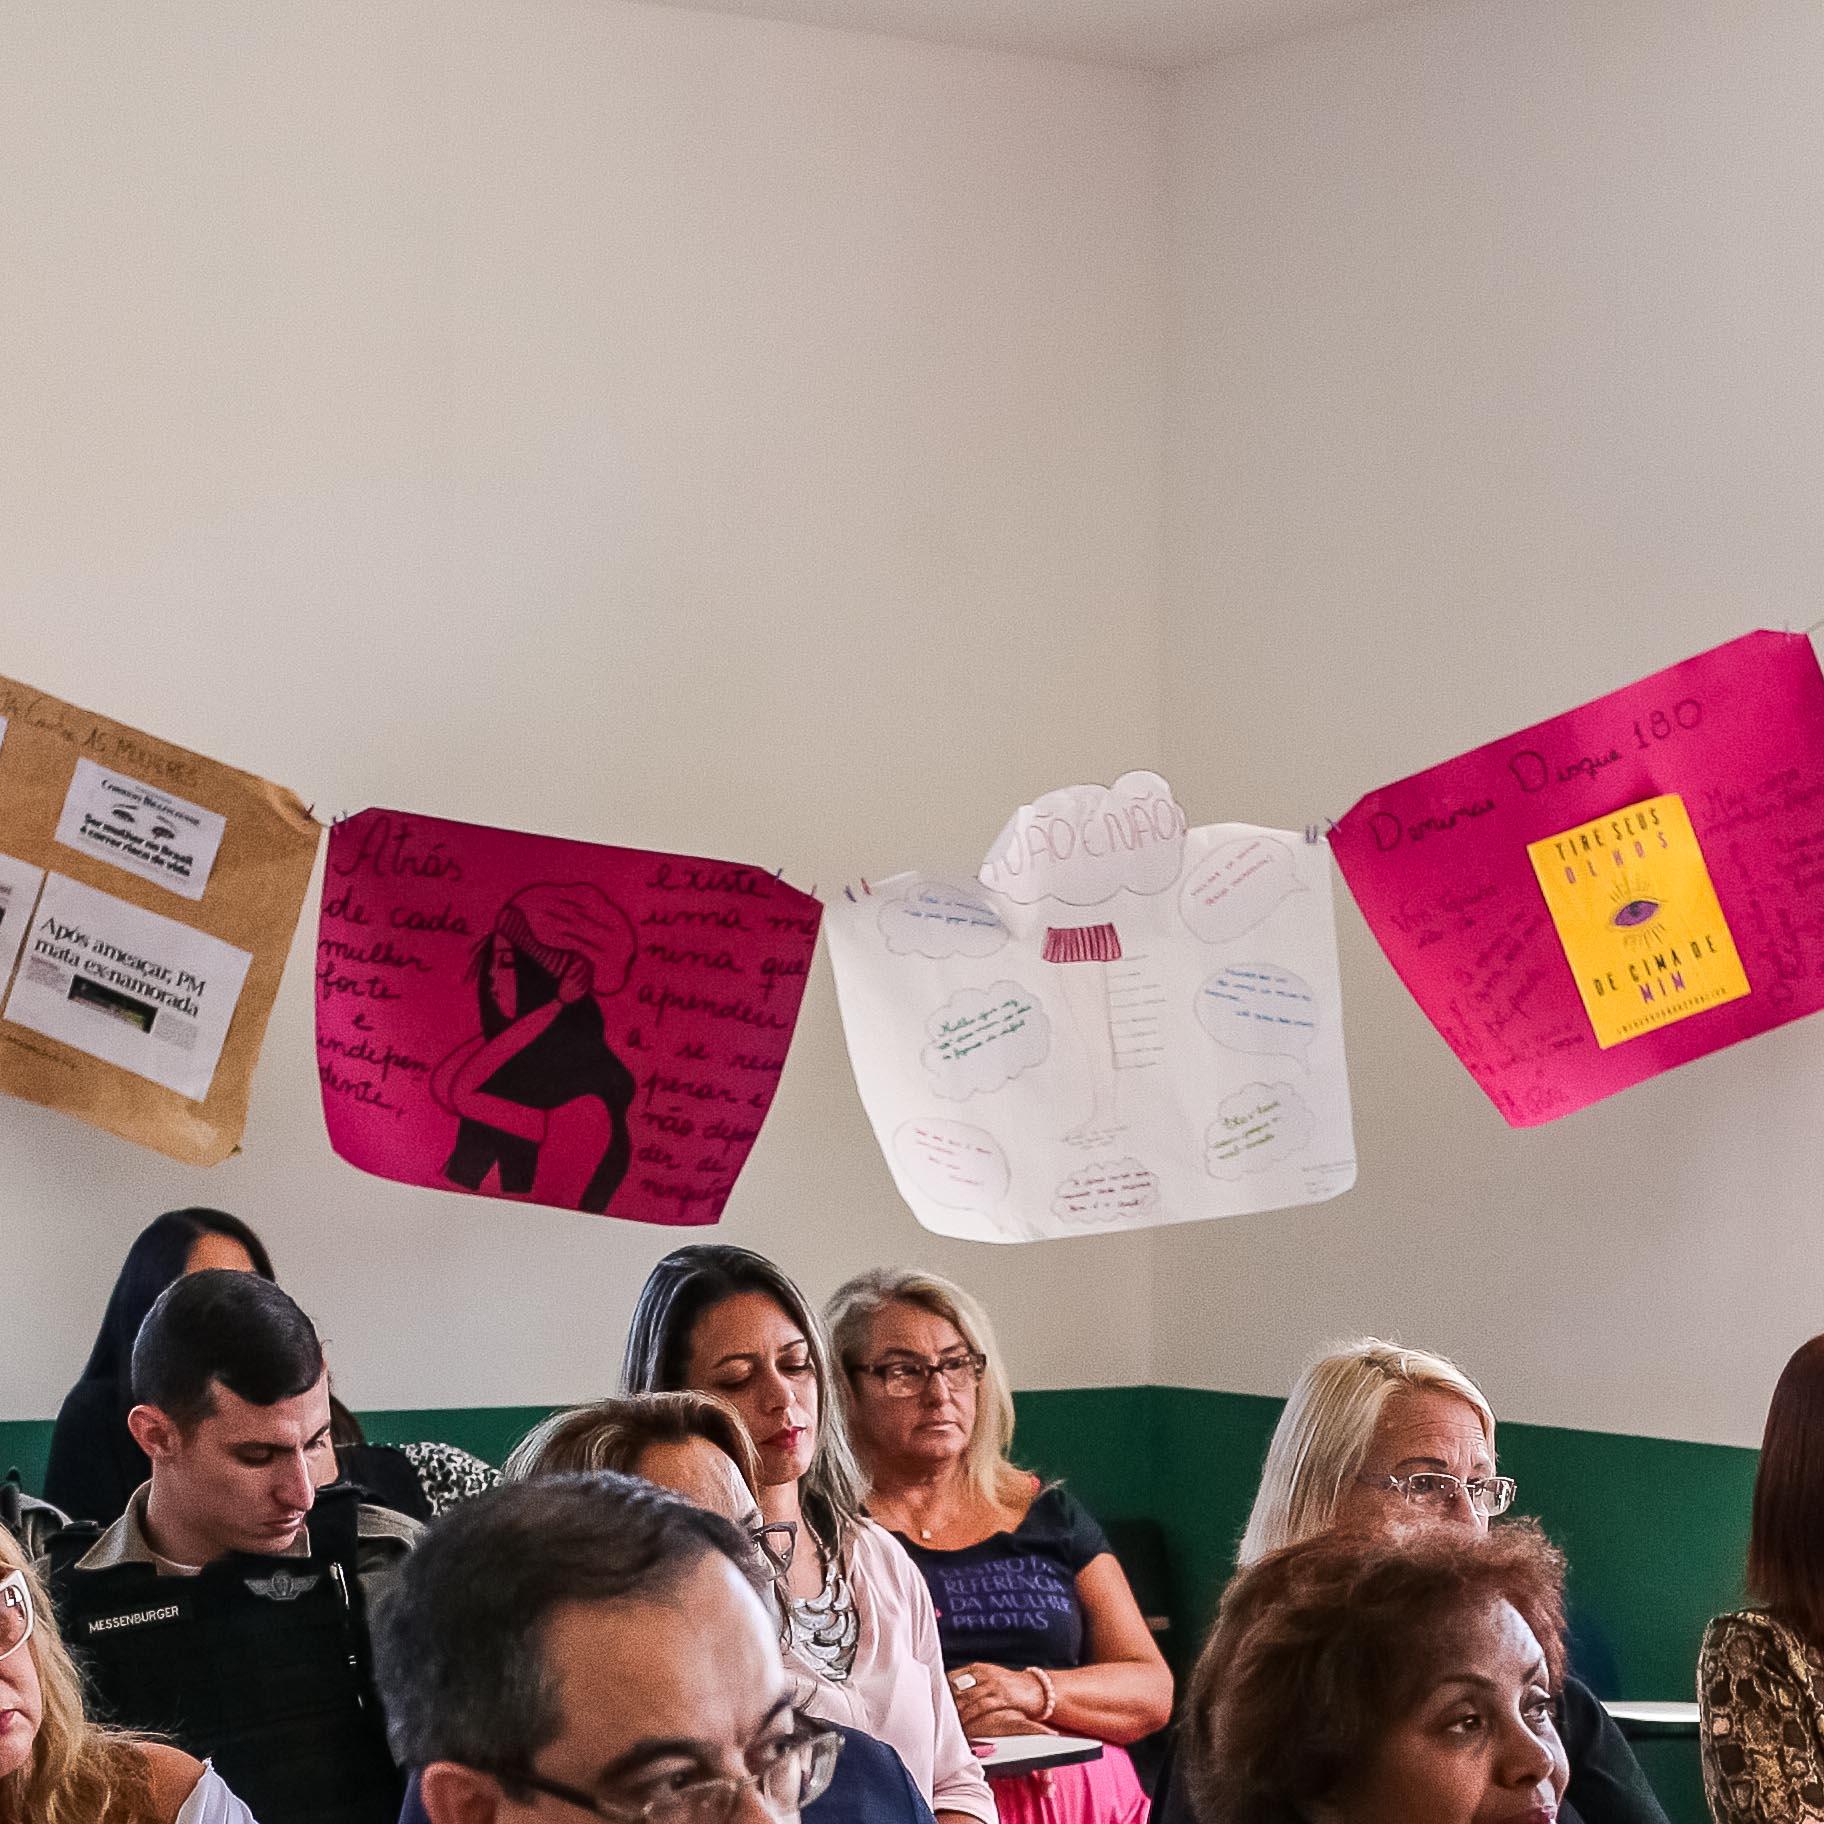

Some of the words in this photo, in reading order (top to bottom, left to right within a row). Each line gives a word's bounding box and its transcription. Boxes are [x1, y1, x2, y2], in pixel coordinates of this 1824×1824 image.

[1508, 749, 1623, 793] Disque
[1634, 698, 1703, 750] 180
[333, 816, 464, 882] Atrás
[992, 813, 1075, 882] NÃO
[1554, 828, 1604, 863] TIRE
[1615, 806, 1663, 842] SEUS
[1566, 830, 1670, 886] OLHOS
[646, 864, 772, 899] existe
[326, 889, 367, 926] de
[389, 899, 472, 937] cada
[641, 906, 753, 932] uma
[41, 916, 89, 948] Após
[93, 939, 172, 985] ameaçar,
[176, 969, 206, 997] PM
[318, 937, 433, 973] mulher
[646, 941, 745, 976] nina
[760, 955, 808, 1001] que
[1592, 973, 1620, 998] DE
[1630, 948, 1682, 984] CIMA
[1692, 934, 1720, 960] DE
[34, 939, 81, 967] mata
[83, 957, 199, 1019] ex-namorada
[317, 966, 402, 1001] forte
[1638, 974, 1687, 1005] MIM
[352, 1012, 374, 1032] e
[636, 981, 790, 1033] aprendeu
[678, 1038, 709, 1062] se
[641, 1071, 740, 1108] perar
[639, 1107, 695, 1138] não
[88, 1605, 180, 1633] MESSENBURGER
[950, 1596, 982, 1612] DA
[952, 1610, 1049, 1631] PELOTAS
